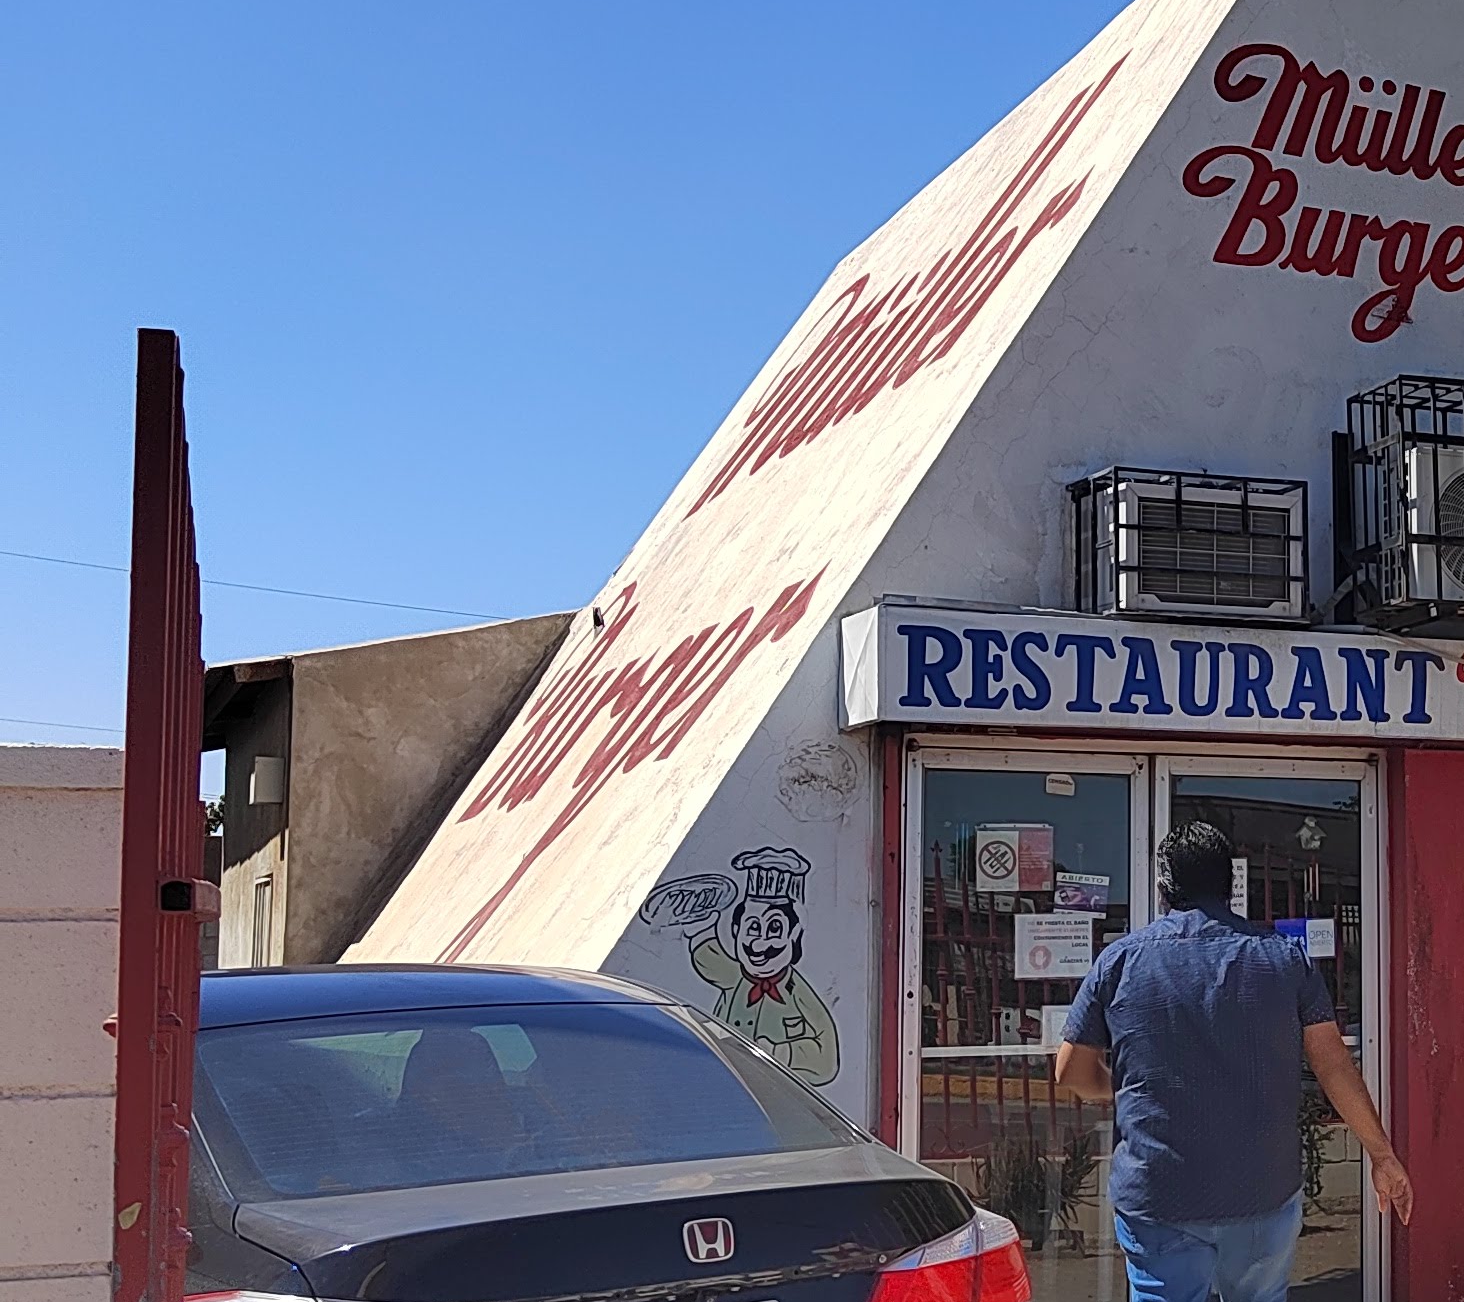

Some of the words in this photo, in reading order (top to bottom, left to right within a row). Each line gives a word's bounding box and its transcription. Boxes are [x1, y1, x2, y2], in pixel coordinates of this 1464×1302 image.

[896, 623, 1446, 725] RESTAURANT
[1061, 874, 1104, 884] ABIERTO
[1308, 930, 1334, 940] OPEN
